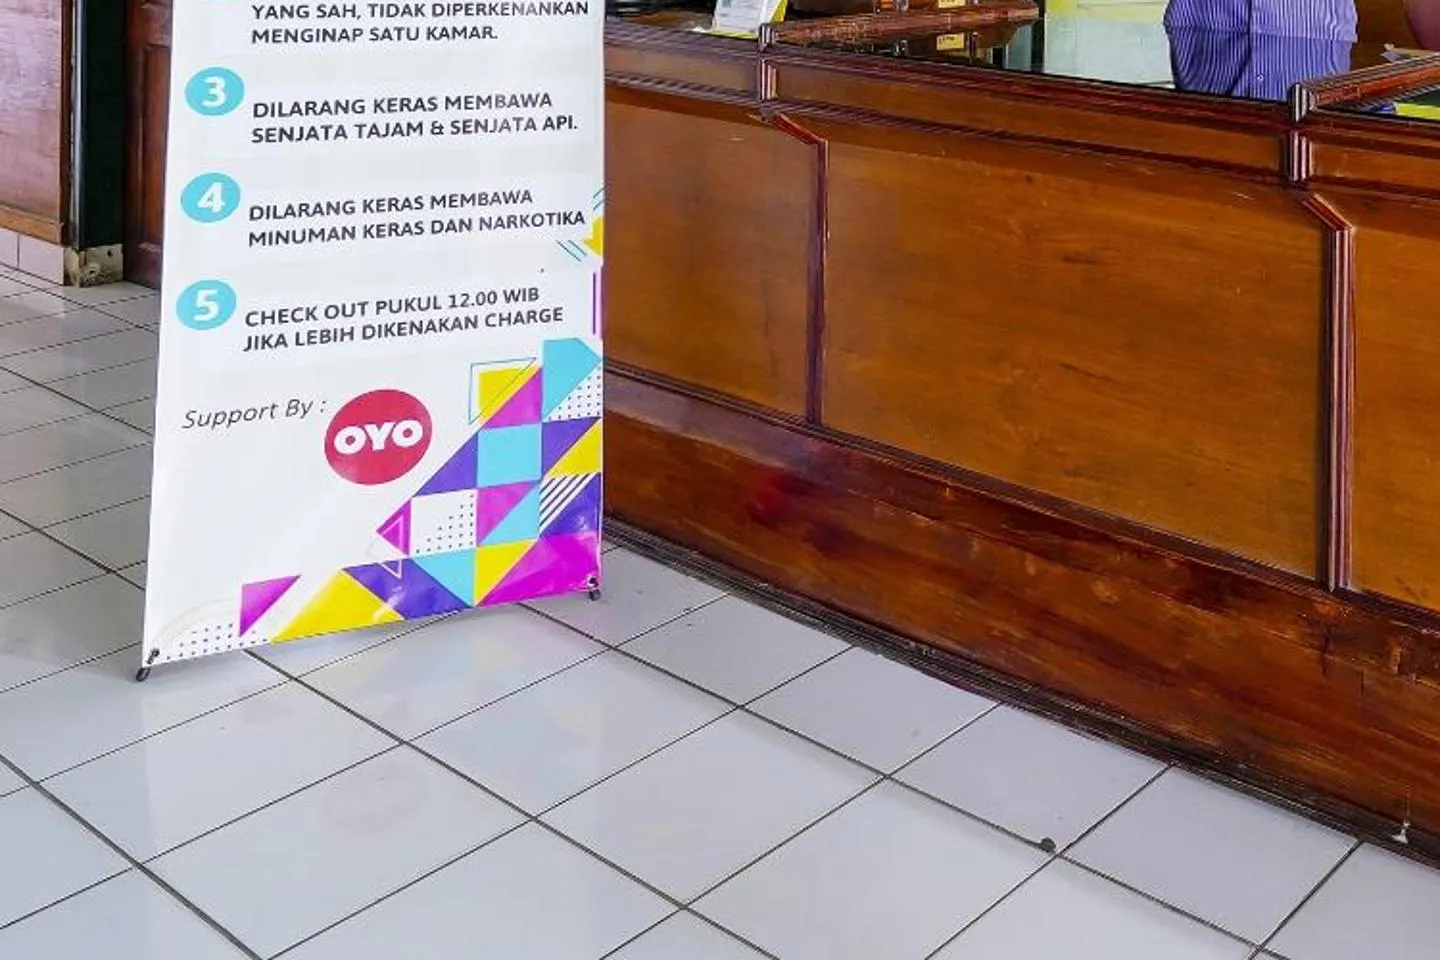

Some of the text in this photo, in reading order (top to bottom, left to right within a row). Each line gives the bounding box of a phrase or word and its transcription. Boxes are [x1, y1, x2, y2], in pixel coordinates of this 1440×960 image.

[251, 0, 589, 21] YANG SAH, TIDAK DIPERKENANKAN
[251, 26, 499, 44] MENGINAP SATU KAMAR.
[202, 76, 227, 107] 3
[252, 93, 552, 119] DILARANG KERAS MEMBAWA
[251, 115, 578, 144] SENJATA TAJAM & SENJATA API.
[197, 183, 224, 212] 4
[249, 190, 533, 221] DILARANG KERAS MEMBAWA
[248, 211, 585, 247] MINUMAN KERAS DAN NARKOTIKA
[192, 289, 218, 321] 5
[245, 287, 540, 327] CHECK OUT PUKUL 12.00 WIB
[244, 307, 564, 353] JIKA LEBIH DIKENAKAN CHARGE
[182, 402, 279, 431] Support
[285, 398, 314, 420] By
[333, 420, 424, 456] OYO
